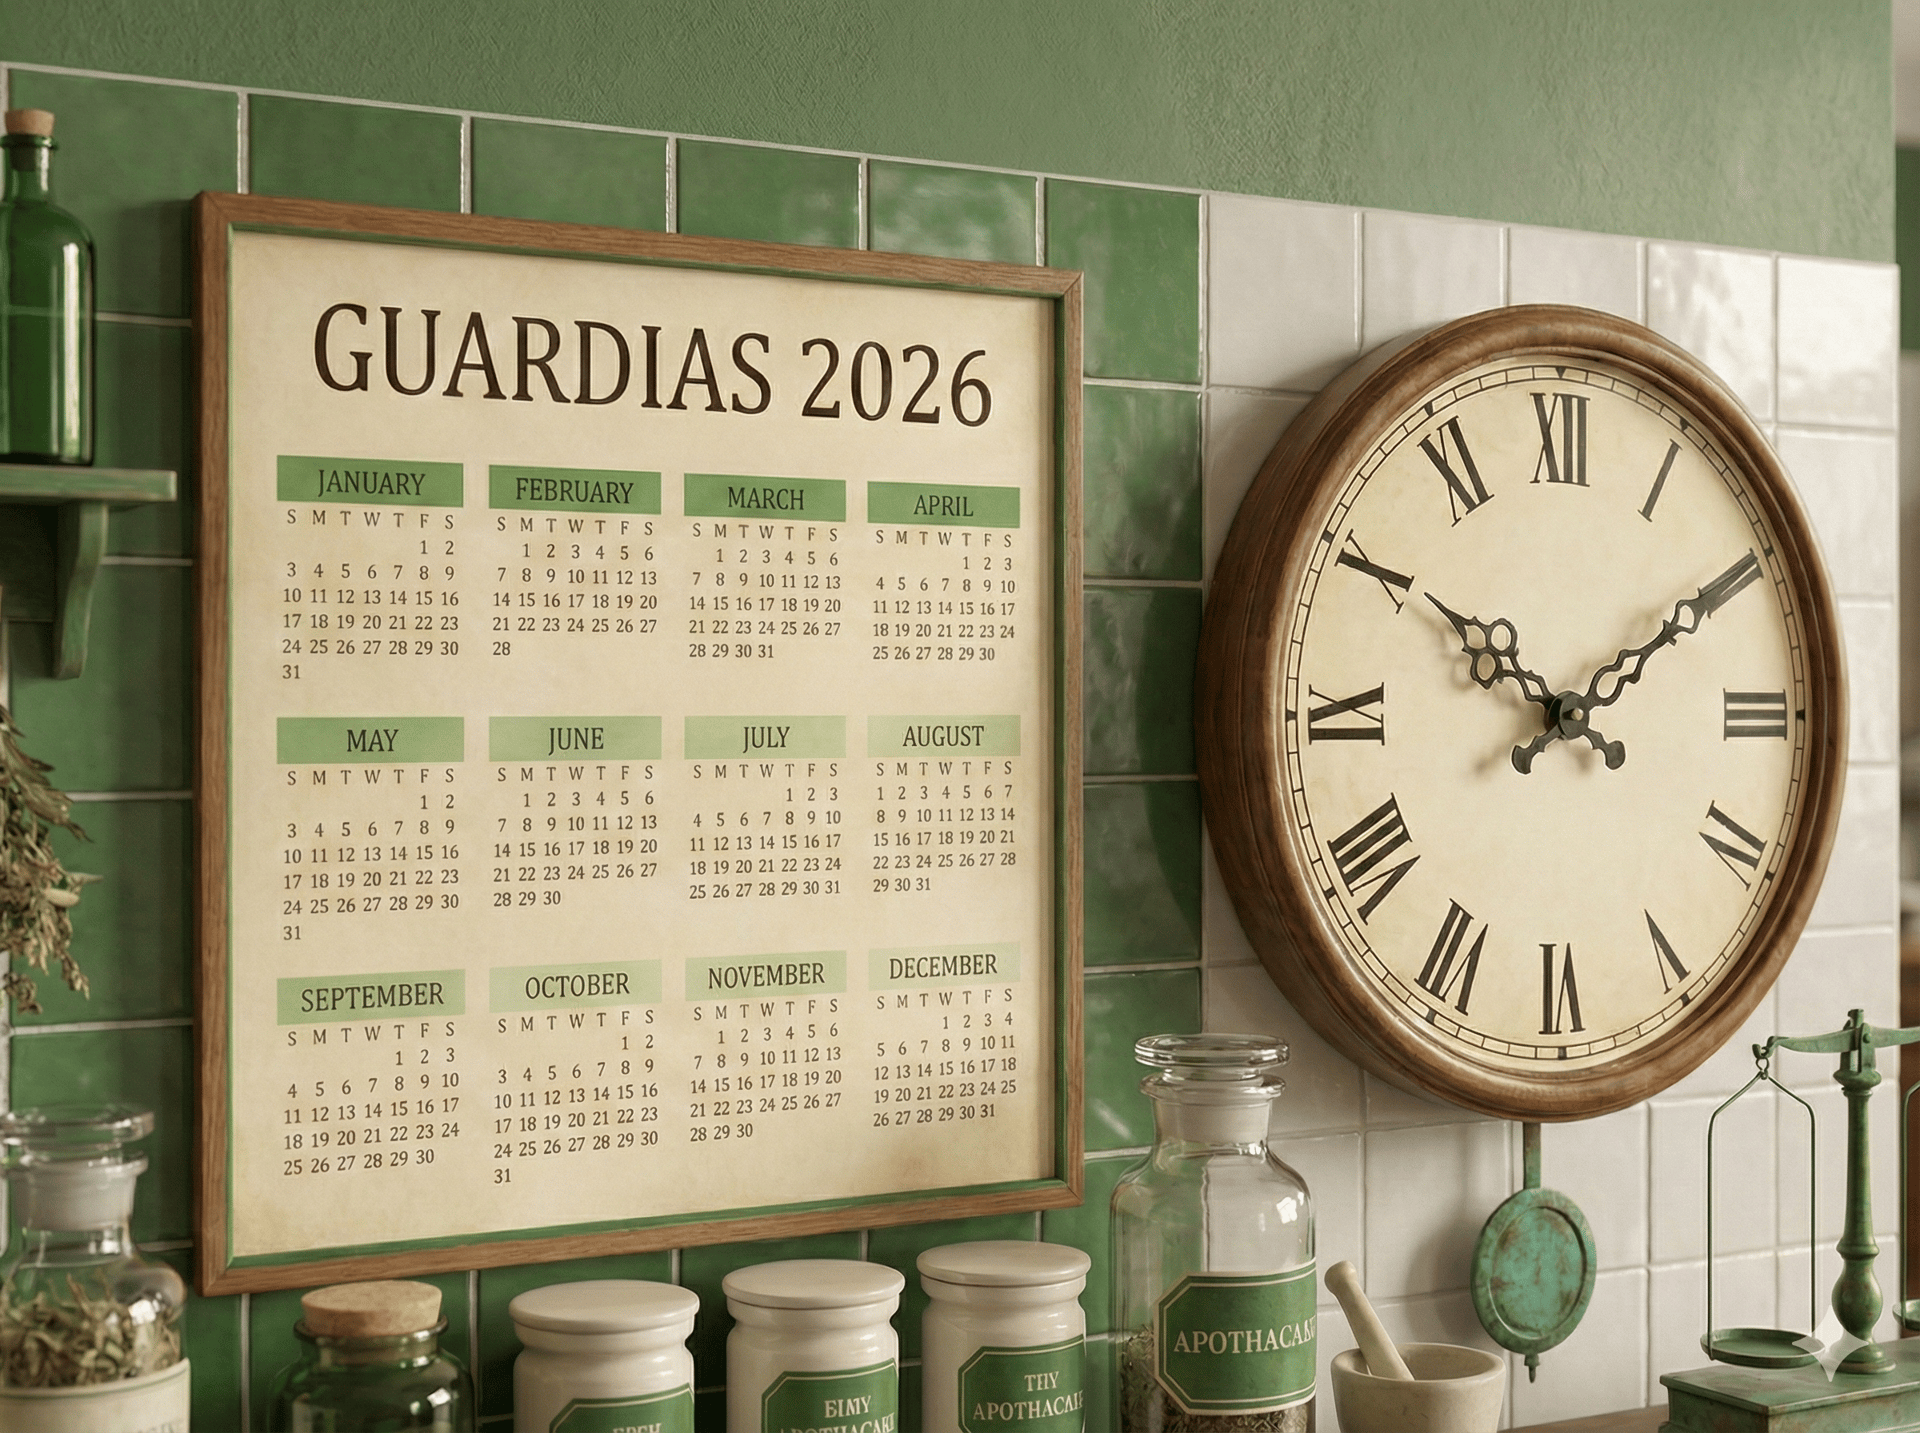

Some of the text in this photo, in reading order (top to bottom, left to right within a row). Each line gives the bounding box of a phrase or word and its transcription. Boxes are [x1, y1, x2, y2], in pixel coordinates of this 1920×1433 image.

[315, 303, 991, 426] GUARDIAS 2026
[1530, 393, 1590, 487] XII
[319, 470, 425, 497] JANUARY
[1417, 416, 1494, 527] XI
[1638, 439, 1681, 522] I
[516, 478, 633, 504] FEBRUARY
[728, 487, 804, 510] MARCH
[914, 495, 973, 516] APRIL
[287, 509, 453, 529] S M T W T F S
[693, 523, 837, 542] S M T W T F S
[287, 562, 454, 581] 3 4 5 6 7 8 9
[1334, 529, 1414, 614] X
[493, 592, 657, 609] 14 15 16 17 18 19 20
[873, 600, 1015, 615] 11 12 13 14 15 16 17
[689, 620, 840, 636] 21 22 23 24 25 26 27
[1308, 682, 1385, 745] IX
[1724, 689, 1787, 741] III
[347, 729, 398, 752] MAY
[548, 728, 603, 756] JUNE
[743, 726, 790, 753] JULY
[903, 726, 984, 746] AUGUST
[498, 765, 653, 782] S M T W T F S
[877, 761, 1011, 776] S M T W T F S
[498, 815, 657, 832] 7 8 9 10 11 12 13
[873, 852, 1016, 869] 22 23 24 25 26 27 28
[1327, 793, 1420, 925] VIII
[690, 880, 840, 899] 25 26 27 28 29 30 31
[284, 894, 459, 915] 24 25 26 27 28 29 30
[1414, 898, 1488, 1016] VII
[1645, 910, 1690, 994] V
[709, 963, 825, 989] NOVEMBER
[890, 954, 997, 979] DECEMBER
[302, 983, 444, 1012] SEPTEMBER
[526, 973, 630, 999] OCTOBER
[1539, 943, 1585, 1034] VI
[498, 1010, 653, 1033] S M T W T F S
[875, 1079, 1016, 1103] 19 20 21 22 23 24 25
[284, 1097, 459, 1124] 11 12 13 14 15 16 17
[690, 1092, 841, 1117] 21 22 23 24 25 26 27
[494, 1131, 658, 1158] 24 25 26 27 28 29 30
